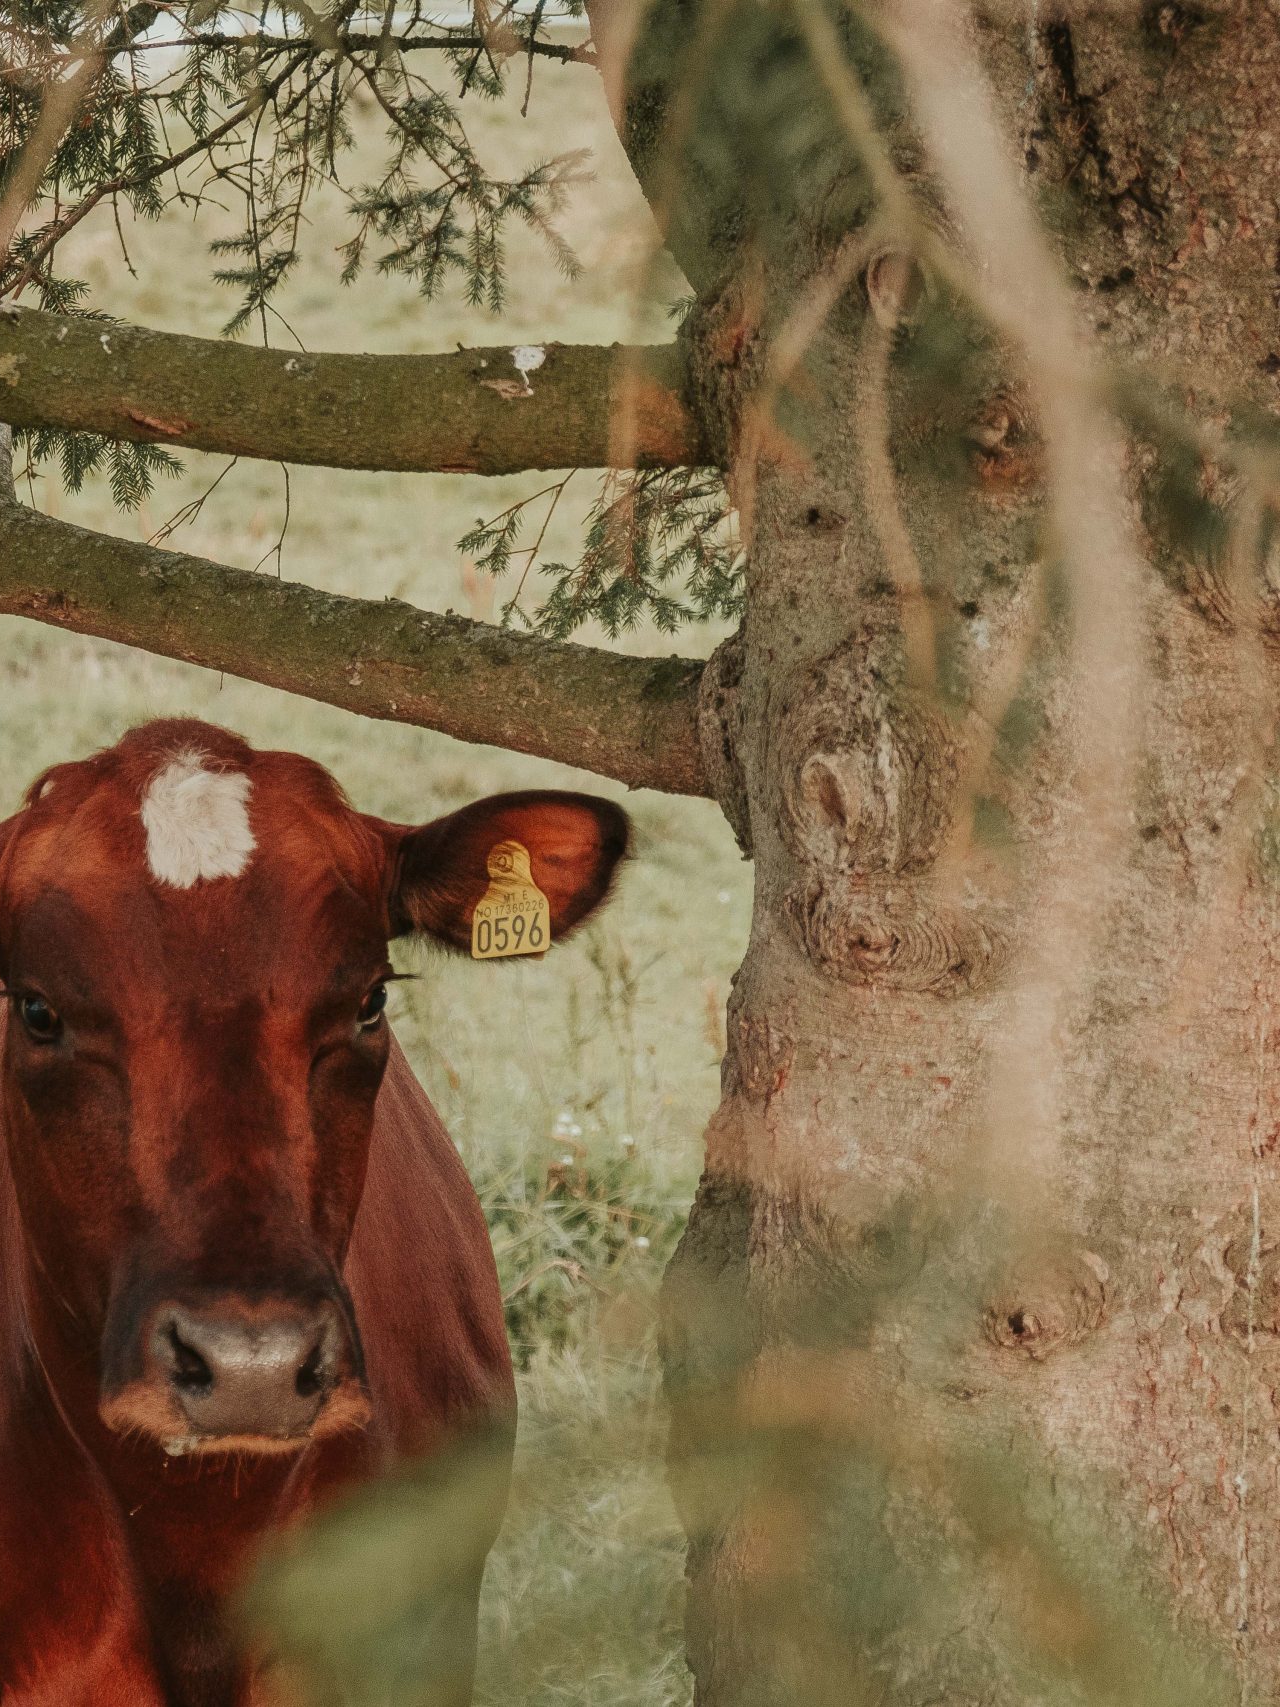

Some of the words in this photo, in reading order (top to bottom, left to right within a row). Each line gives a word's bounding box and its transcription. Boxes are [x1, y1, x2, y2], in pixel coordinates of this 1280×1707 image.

[476, 906, 491, 918] NO
[495, 898, 544, 915] 17360226
[477, 912, 543, 953] 0596
